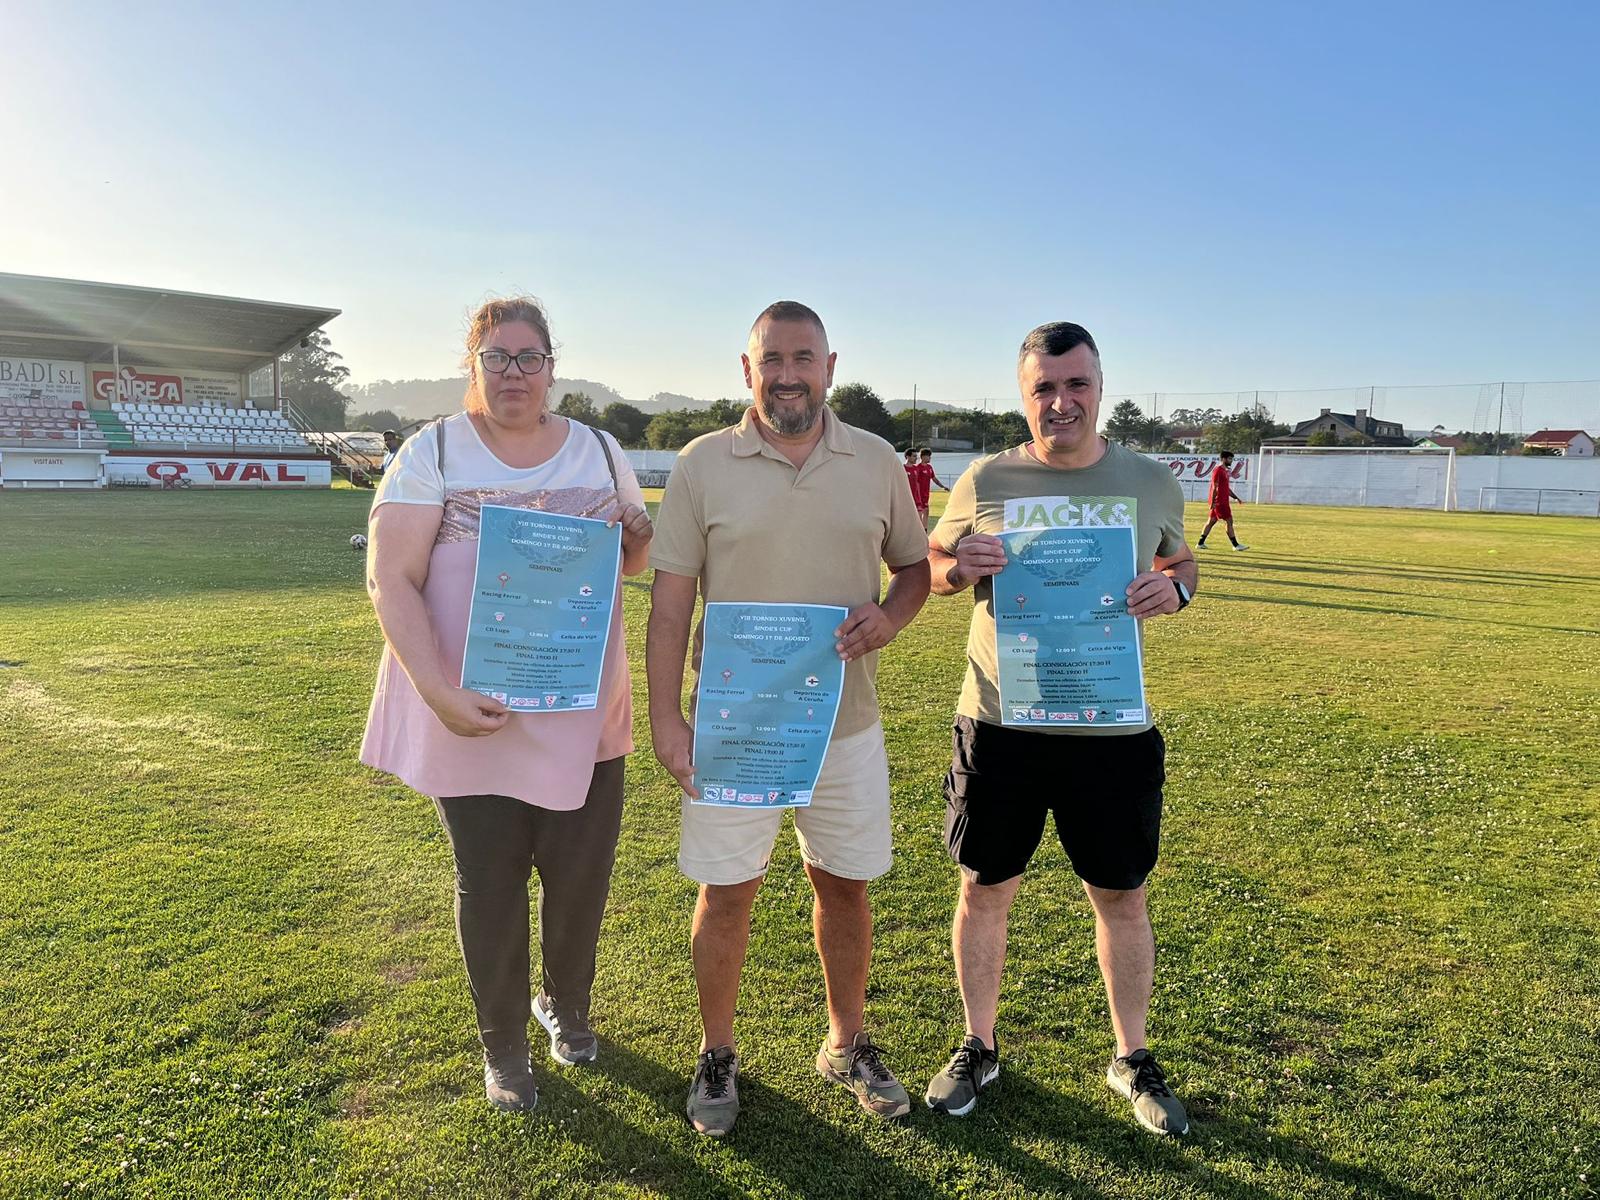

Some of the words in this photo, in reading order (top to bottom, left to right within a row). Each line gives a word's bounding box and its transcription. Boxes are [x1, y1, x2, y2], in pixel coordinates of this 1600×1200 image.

[59, 370, 81, 385] S.L.
[96, 367, 180, 402] GAIRESA
[206, 462, 306, 482] VAL
[1040, 660, 1088, 668] CONSOLACIÓN
